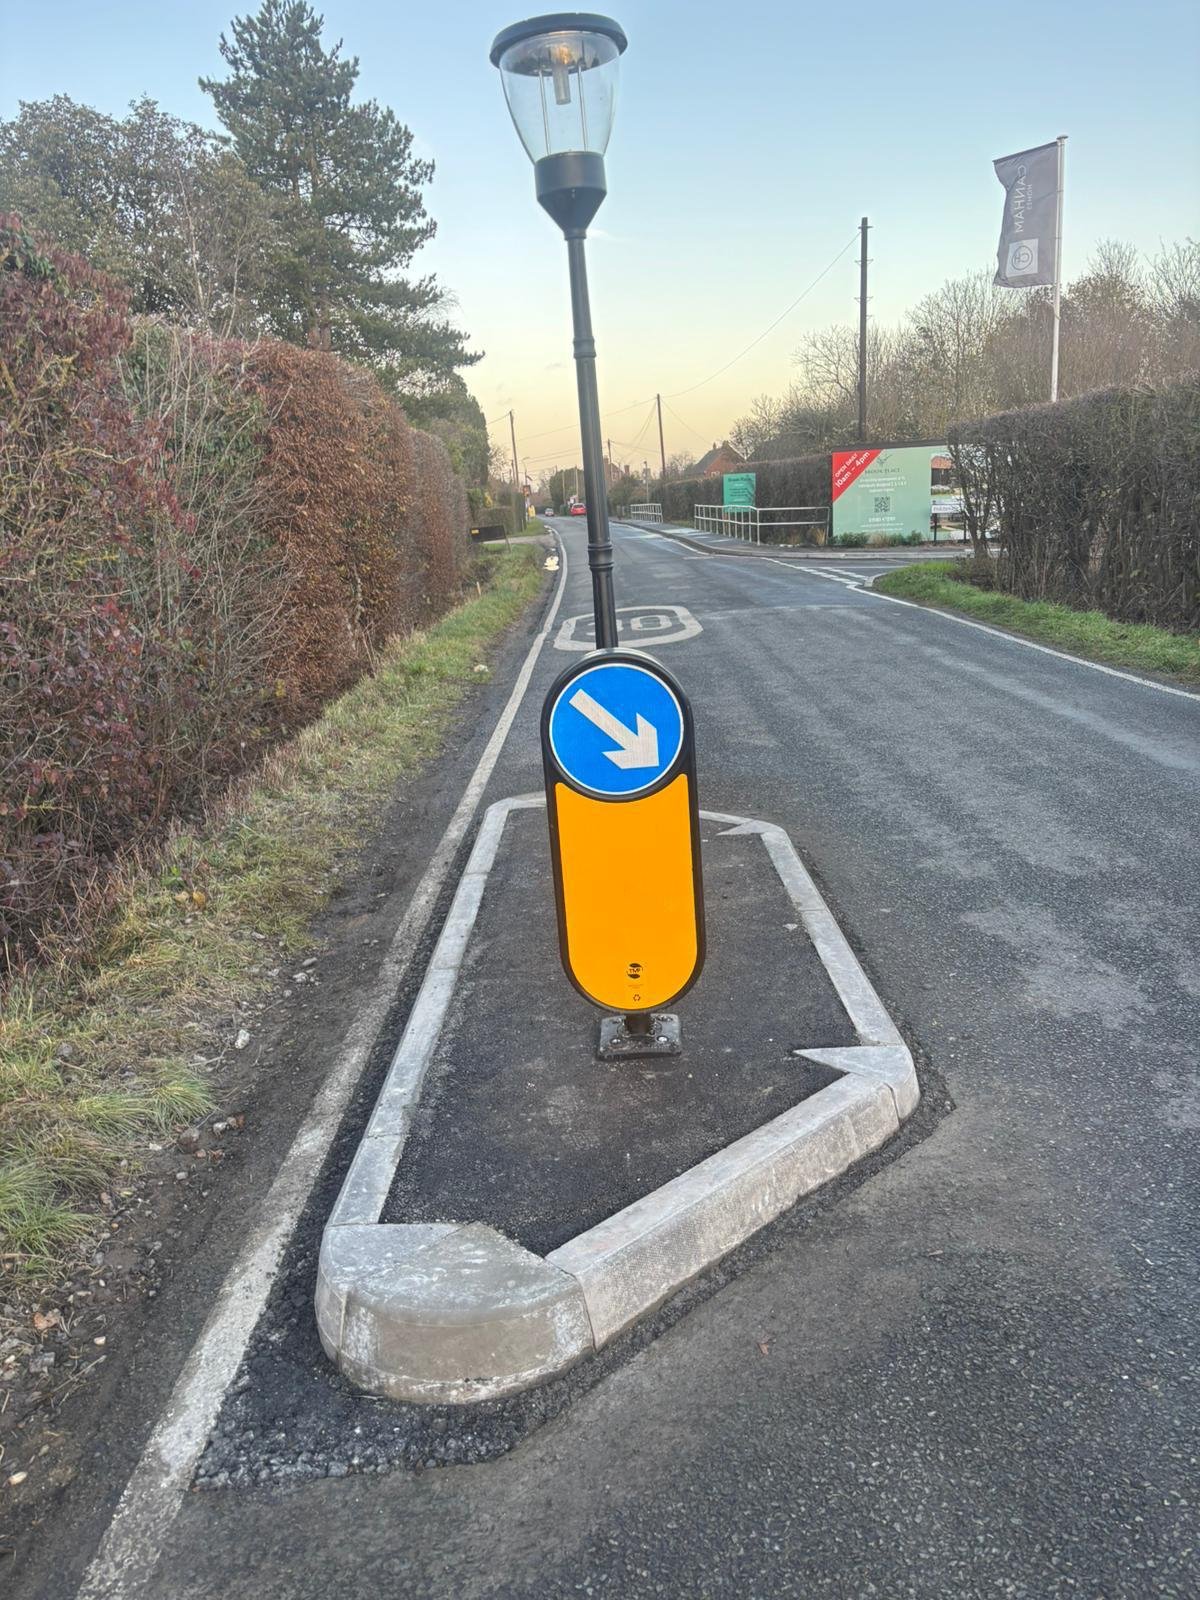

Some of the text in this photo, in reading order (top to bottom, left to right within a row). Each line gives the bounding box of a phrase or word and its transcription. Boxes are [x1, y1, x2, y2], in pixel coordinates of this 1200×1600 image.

[835, 471, 852, 488] 10am
[855, 452, 870, 467] 4pm
[835, 464, 847, 478] OPEN
